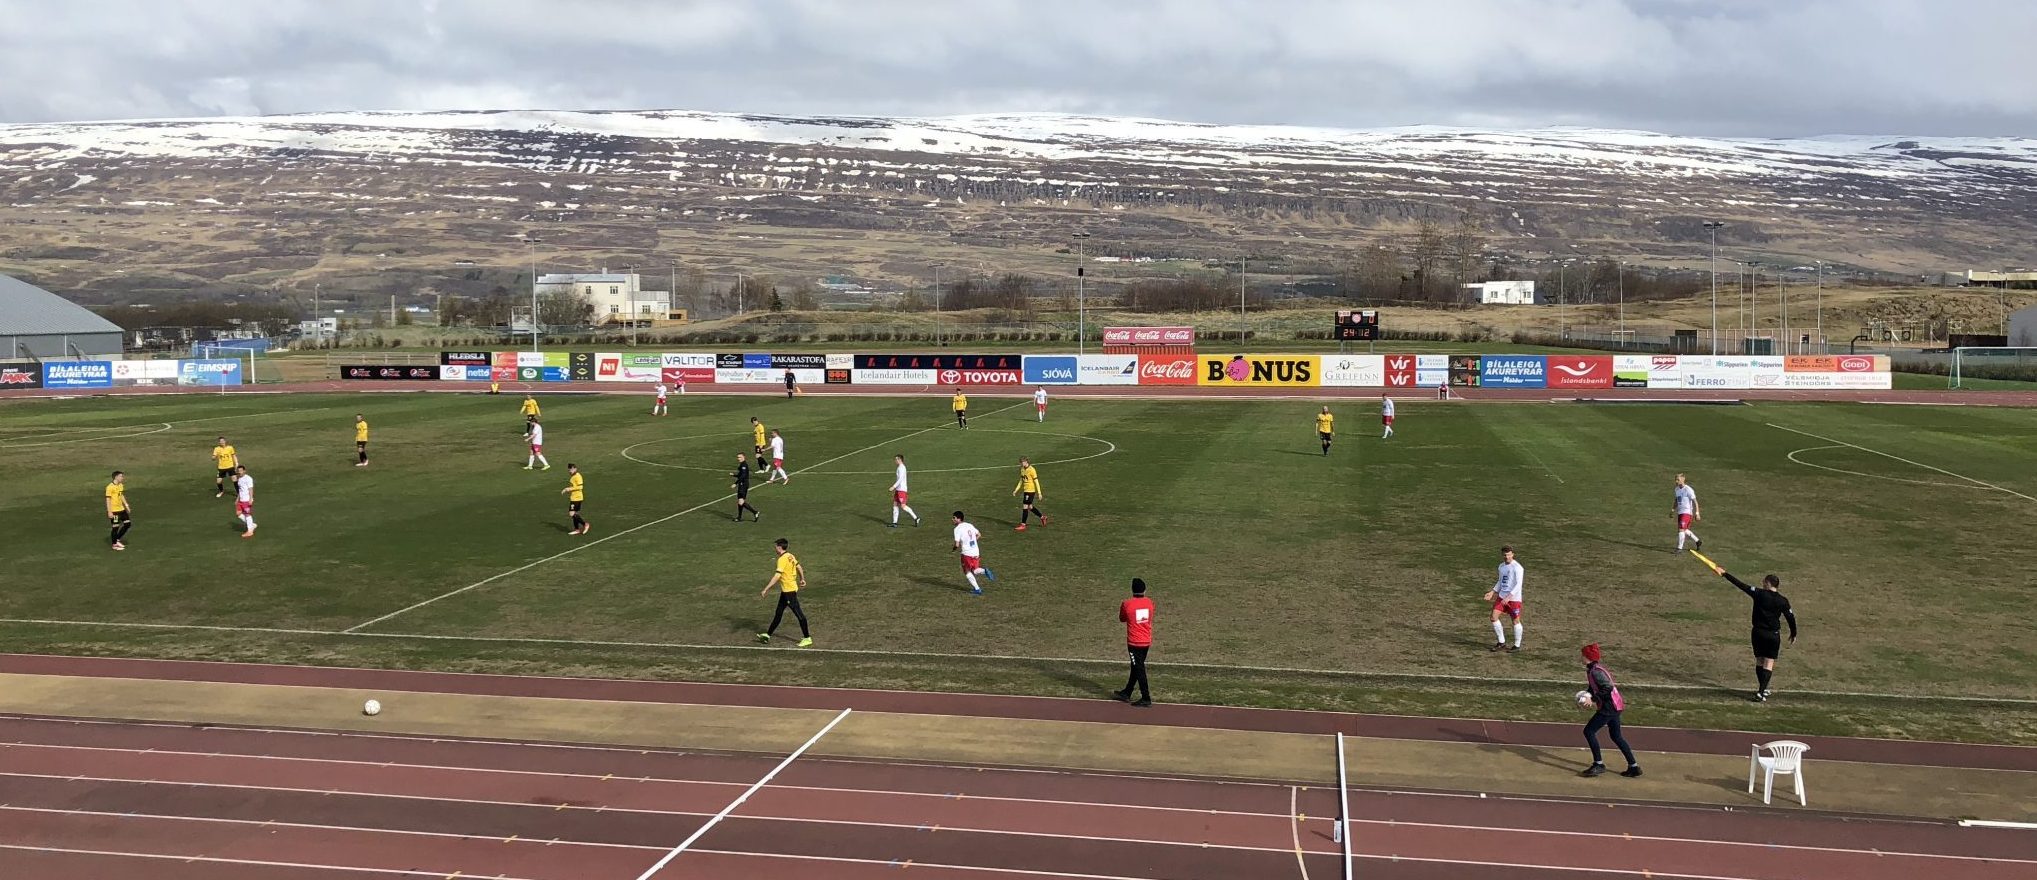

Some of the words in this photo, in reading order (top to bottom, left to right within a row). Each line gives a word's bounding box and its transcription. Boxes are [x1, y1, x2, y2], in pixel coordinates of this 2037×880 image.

[664, 356, 715, 365] VALITOR
[771, 356, 826, 364] RAKARASTOFA
[1389, 356, 1411, 370] vis
[1486, 360, 1542, 369] BÍLALEIGA
[50, 365, 106, 373] BÍLALEIGA
[602, 362, 616, 371] N1
[861, 371, 901, 379] Icelandair
[903, 371, 928, 379] Hotels
[963, 372, 1018, 383] TOYOTA
[1042, 367, 1073, 379] SJÓVÁ
[1389, 371, 1411, 386] vis
